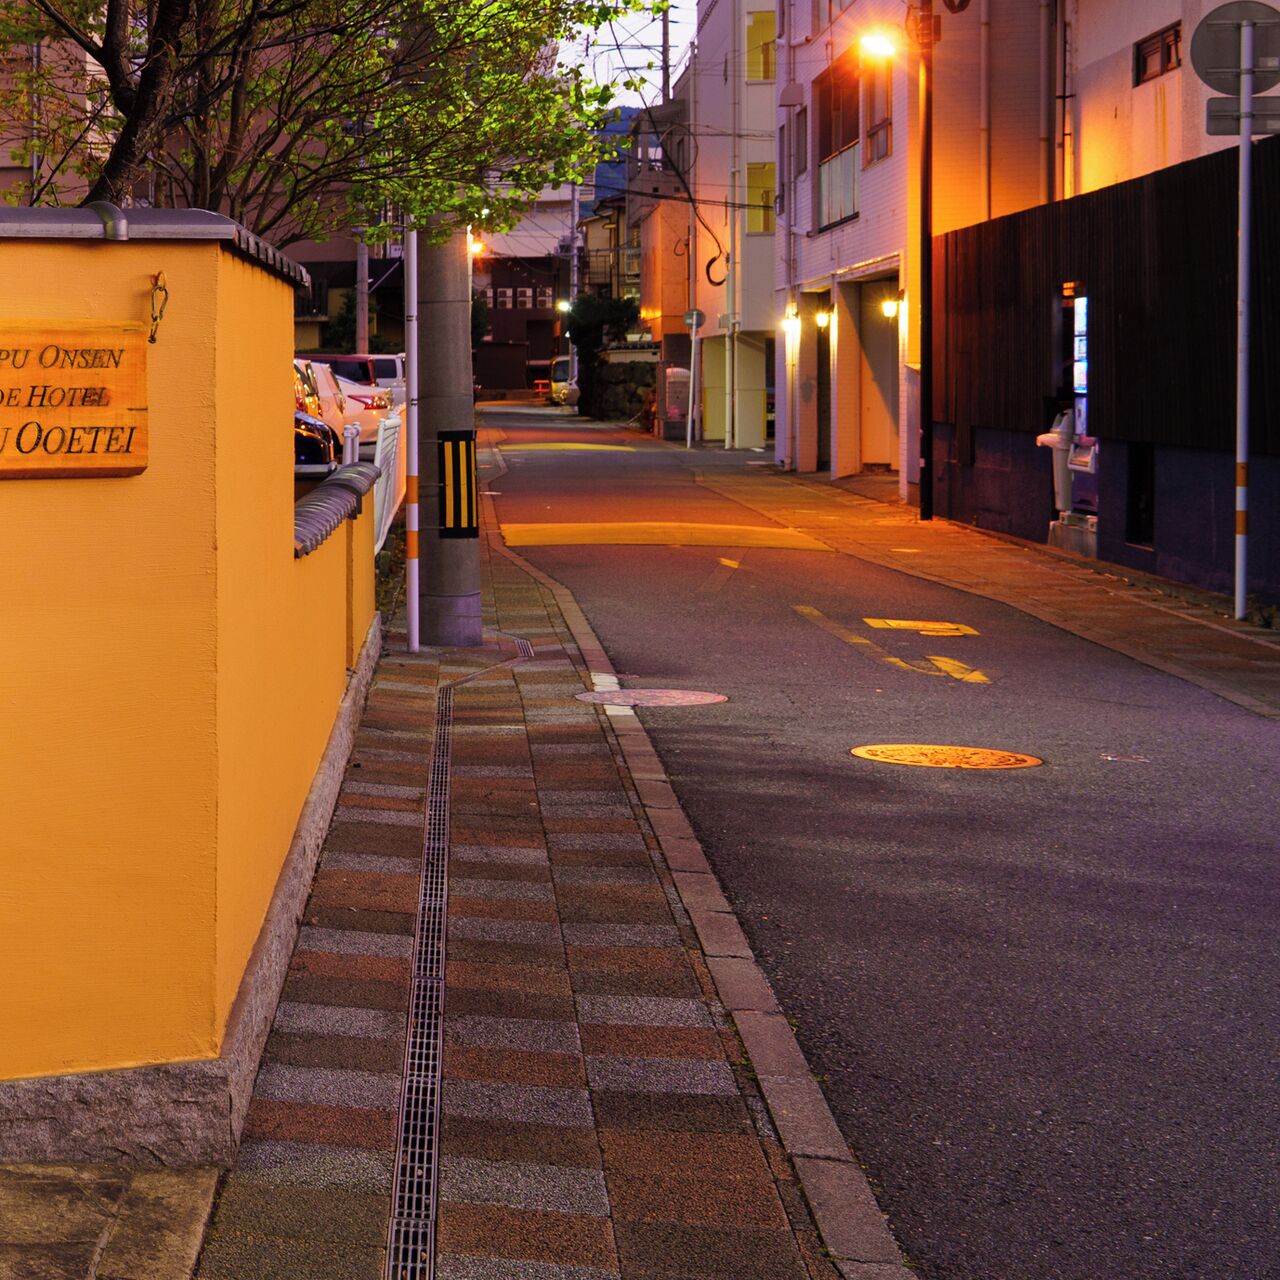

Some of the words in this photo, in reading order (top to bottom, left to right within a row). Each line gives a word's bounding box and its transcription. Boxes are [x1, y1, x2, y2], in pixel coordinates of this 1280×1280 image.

[38, 344, 126, 369] ONSEN
[25, 385, 111, 408] HOTEL
[16, 421, 137, 455] OOETEI
